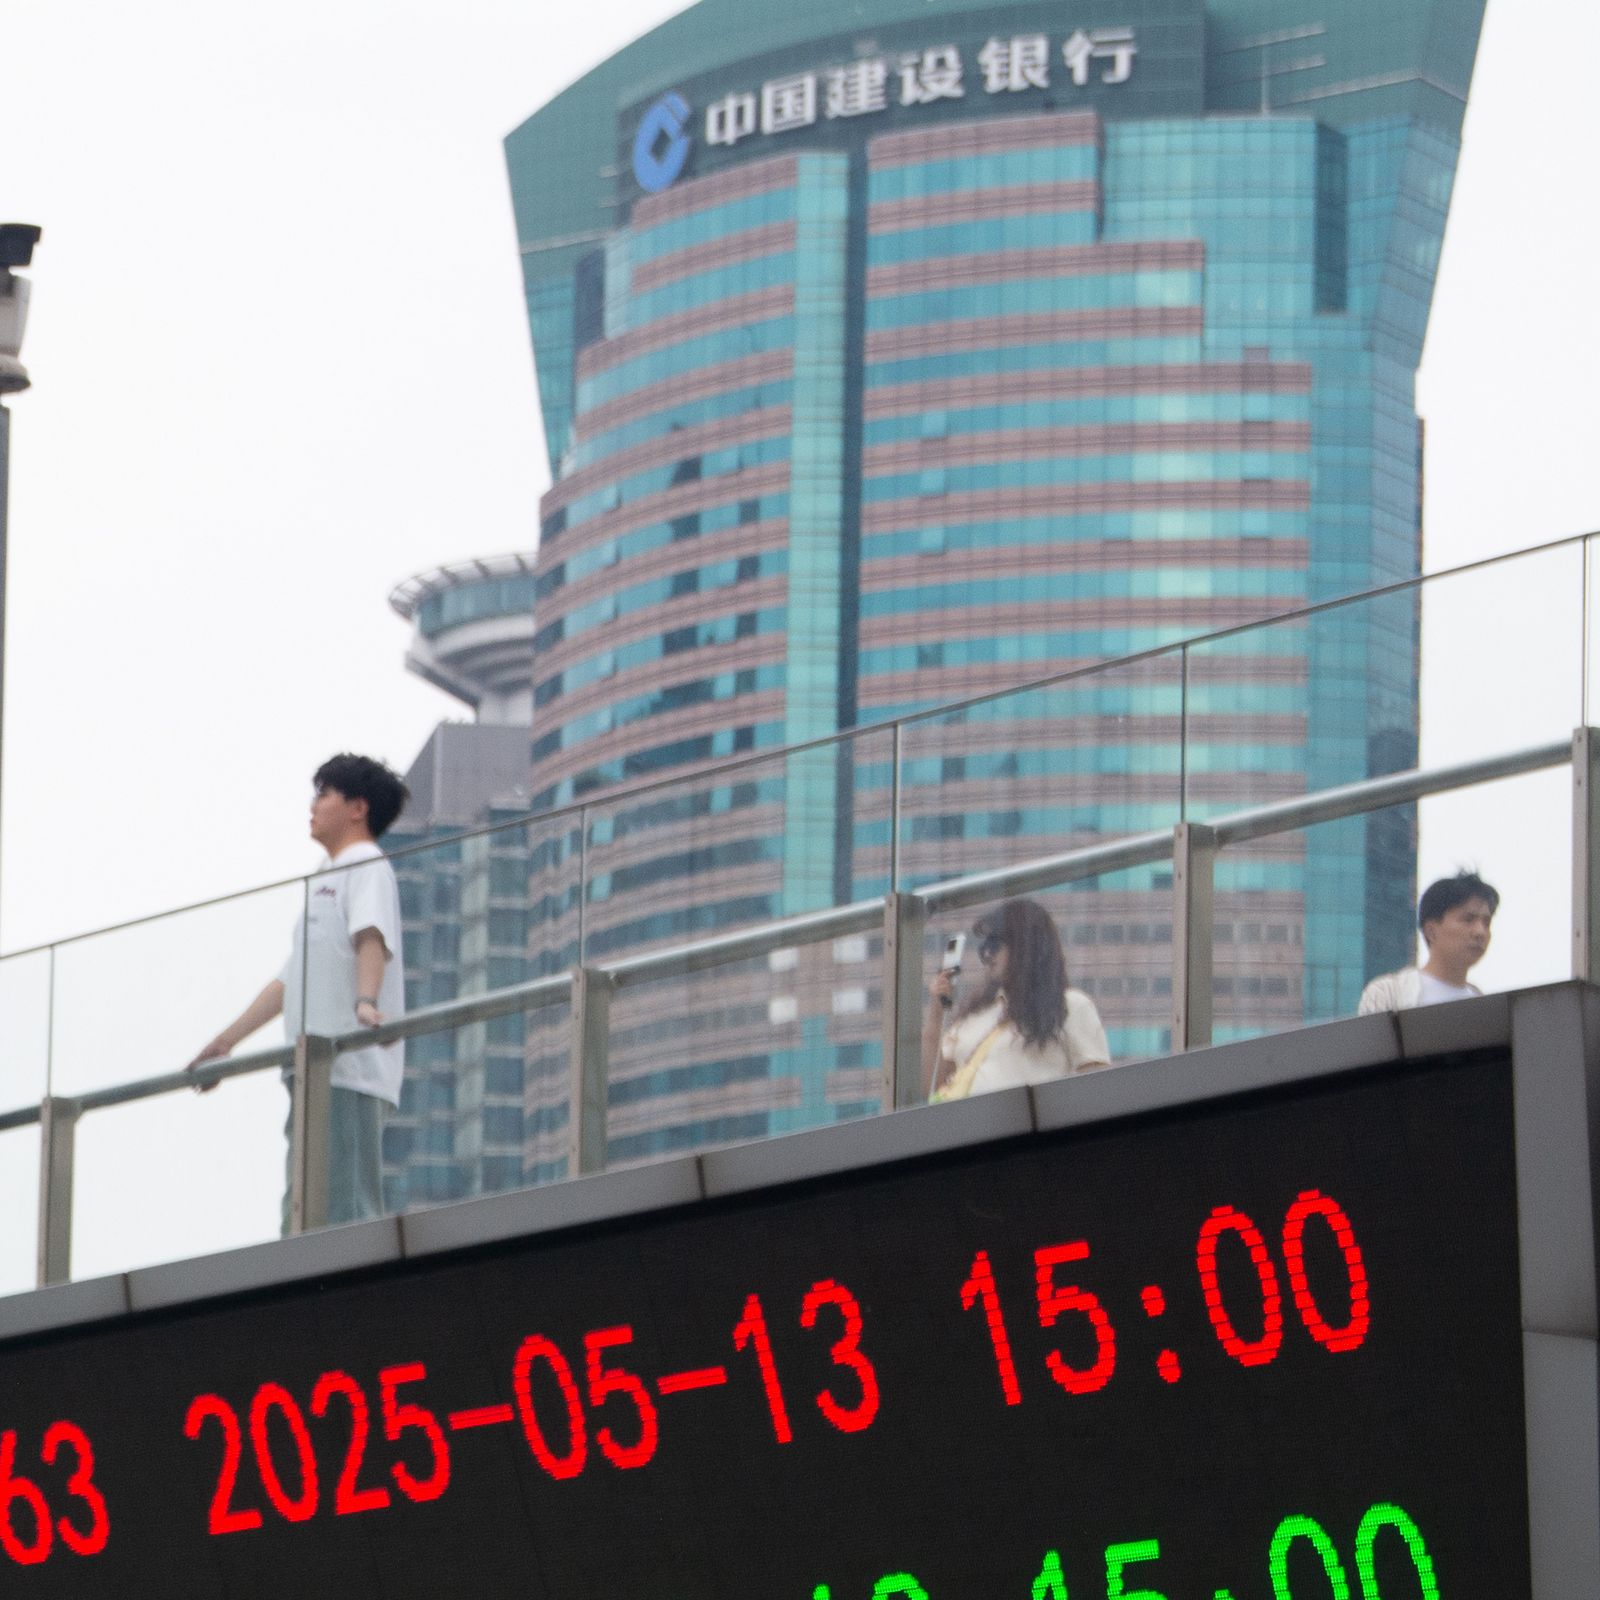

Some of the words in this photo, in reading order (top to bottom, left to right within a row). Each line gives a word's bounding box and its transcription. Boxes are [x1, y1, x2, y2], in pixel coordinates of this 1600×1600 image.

[706, 28, 1136, 145] 中国建设银行
[184, 1277, 881, 1536] 2025-05-13
[960, 1188, 1372, 1407] 15:00
